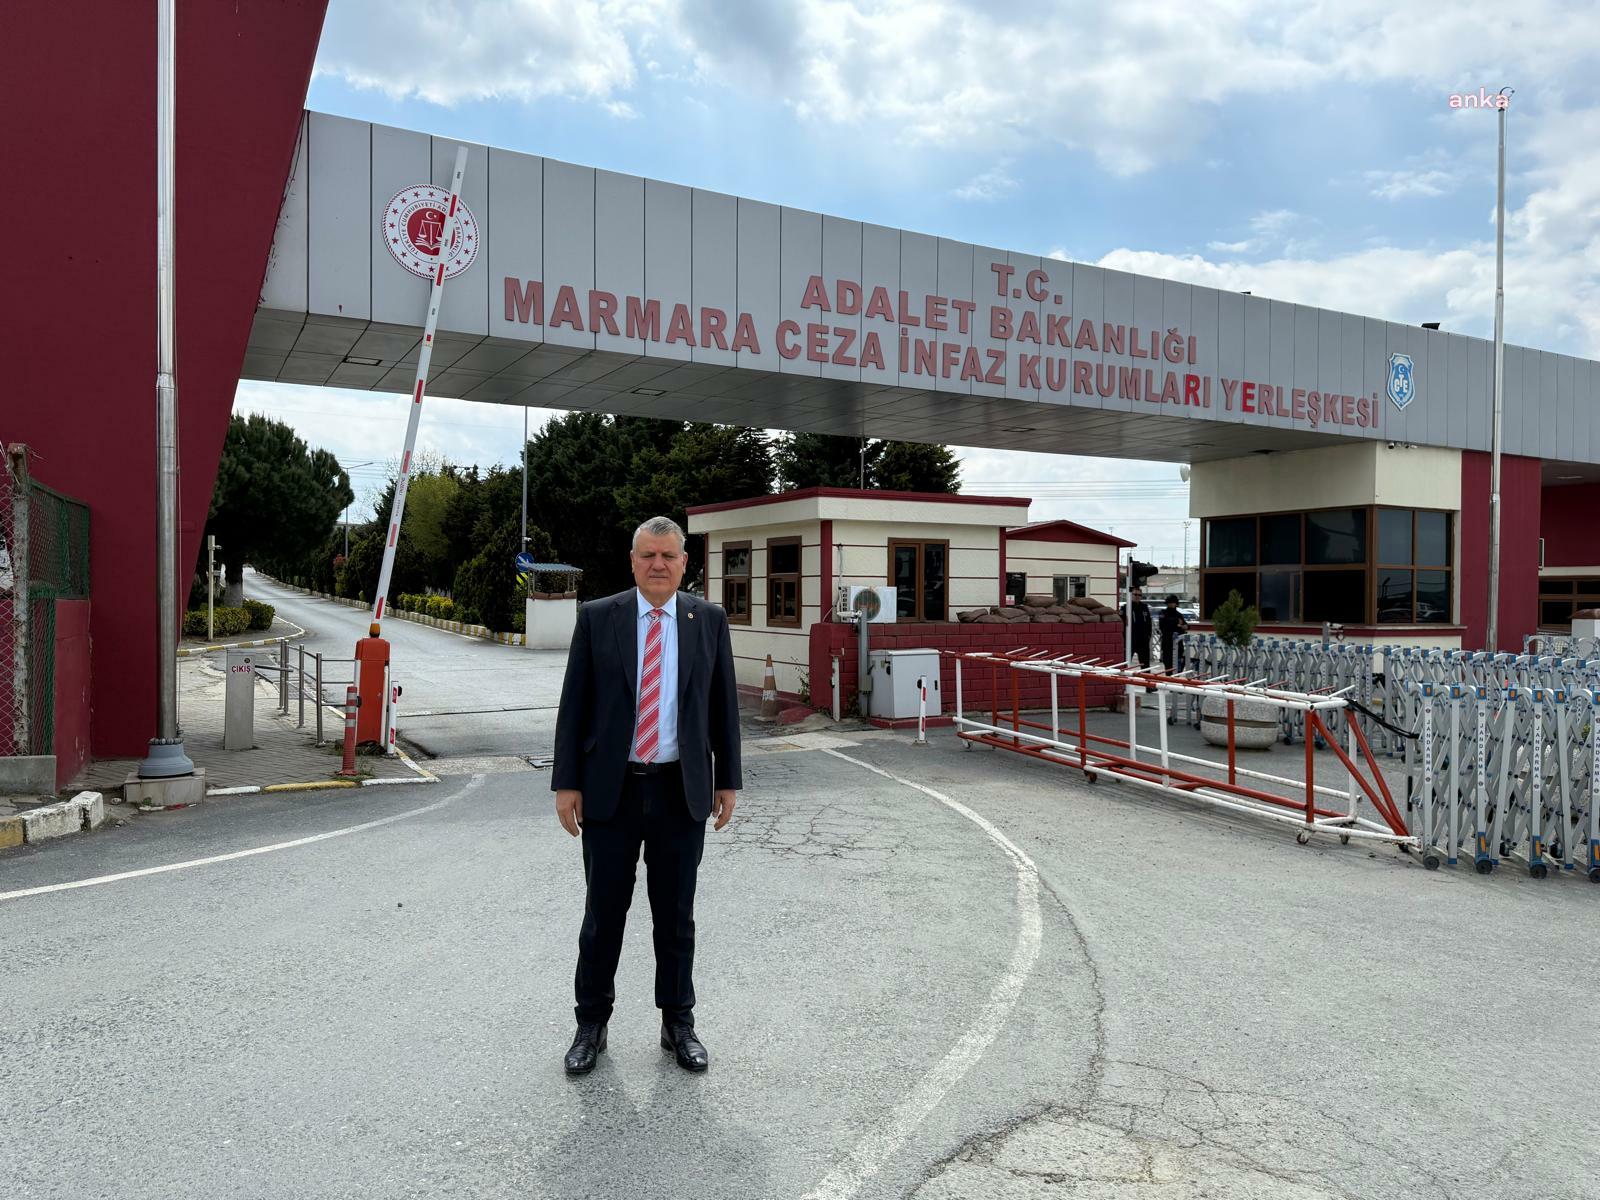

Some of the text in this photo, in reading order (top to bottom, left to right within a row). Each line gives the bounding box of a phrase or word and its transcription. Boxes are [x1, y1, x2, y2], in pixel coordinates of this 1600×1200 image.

[800, 275, 1197, 365] ADALET BAKANLIĞI
[991, 262, 1064, 305] T.C.
[504, 276, 1379, 429] MARMARA CEZA İNFAZ KURUMLARI YERLEŞKESİ
